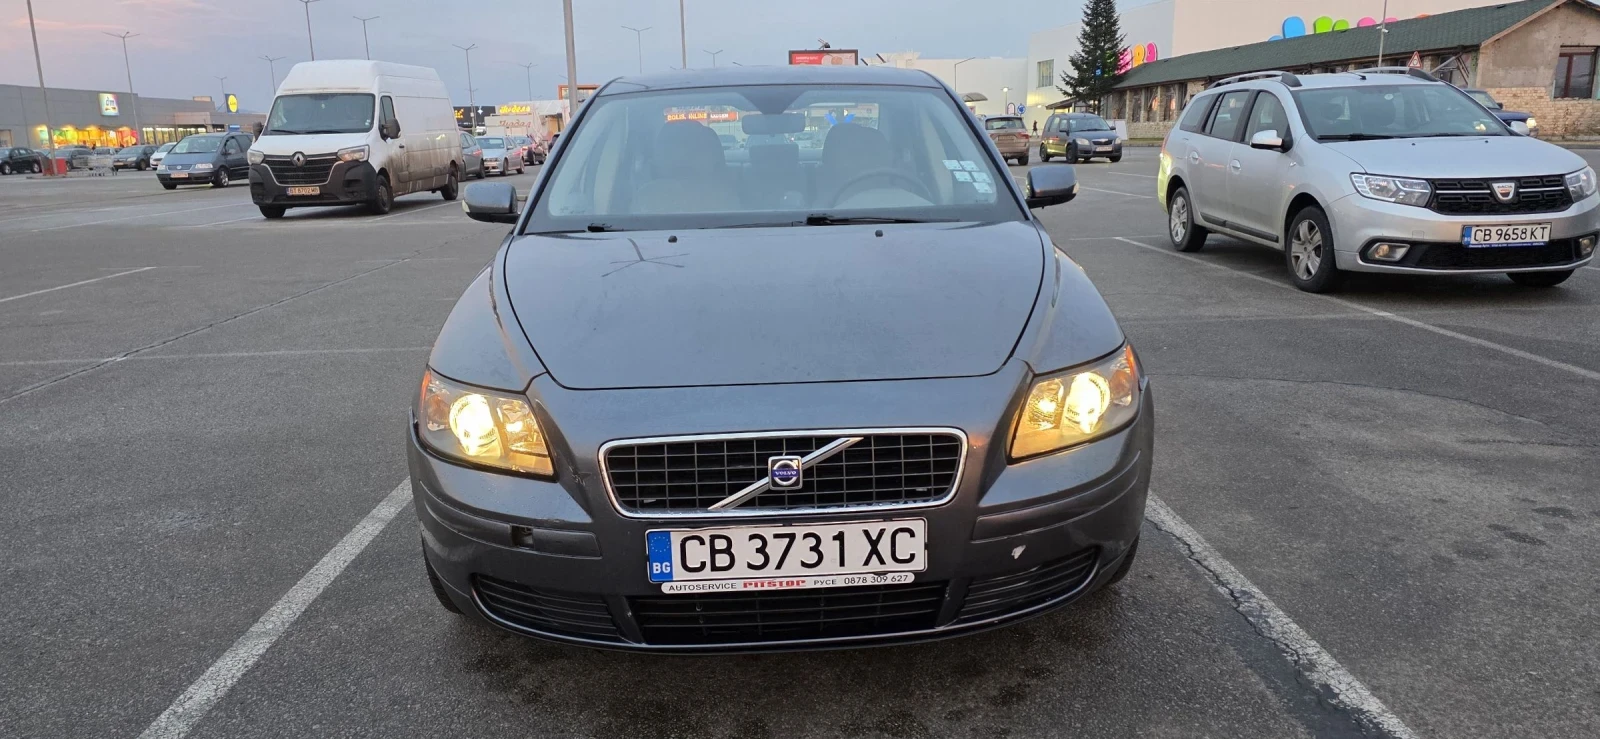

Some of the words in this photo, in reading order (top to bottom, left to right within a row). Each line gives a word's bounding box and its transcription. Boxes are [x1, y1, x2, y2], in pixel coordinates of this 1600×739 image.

[1474, 228, 1492, 242] CB
[1496, 228, 1528, 242] 9658
[1530, 226, 1548, 240] KT
[680, 534, 736, 573] CB
[746, 531, 847, 571] 3731
[862, 527, 916, 567] XC
[652, 561, 671, 574] BG
[668, 581, 737, 592] AUTOSERVICE
[742, 579, 806, 588] PITSTOP
[843, 576, 868, 585] 0878
[869, 575, 889, 584] 309
[890, 574, 909, 583] 627
